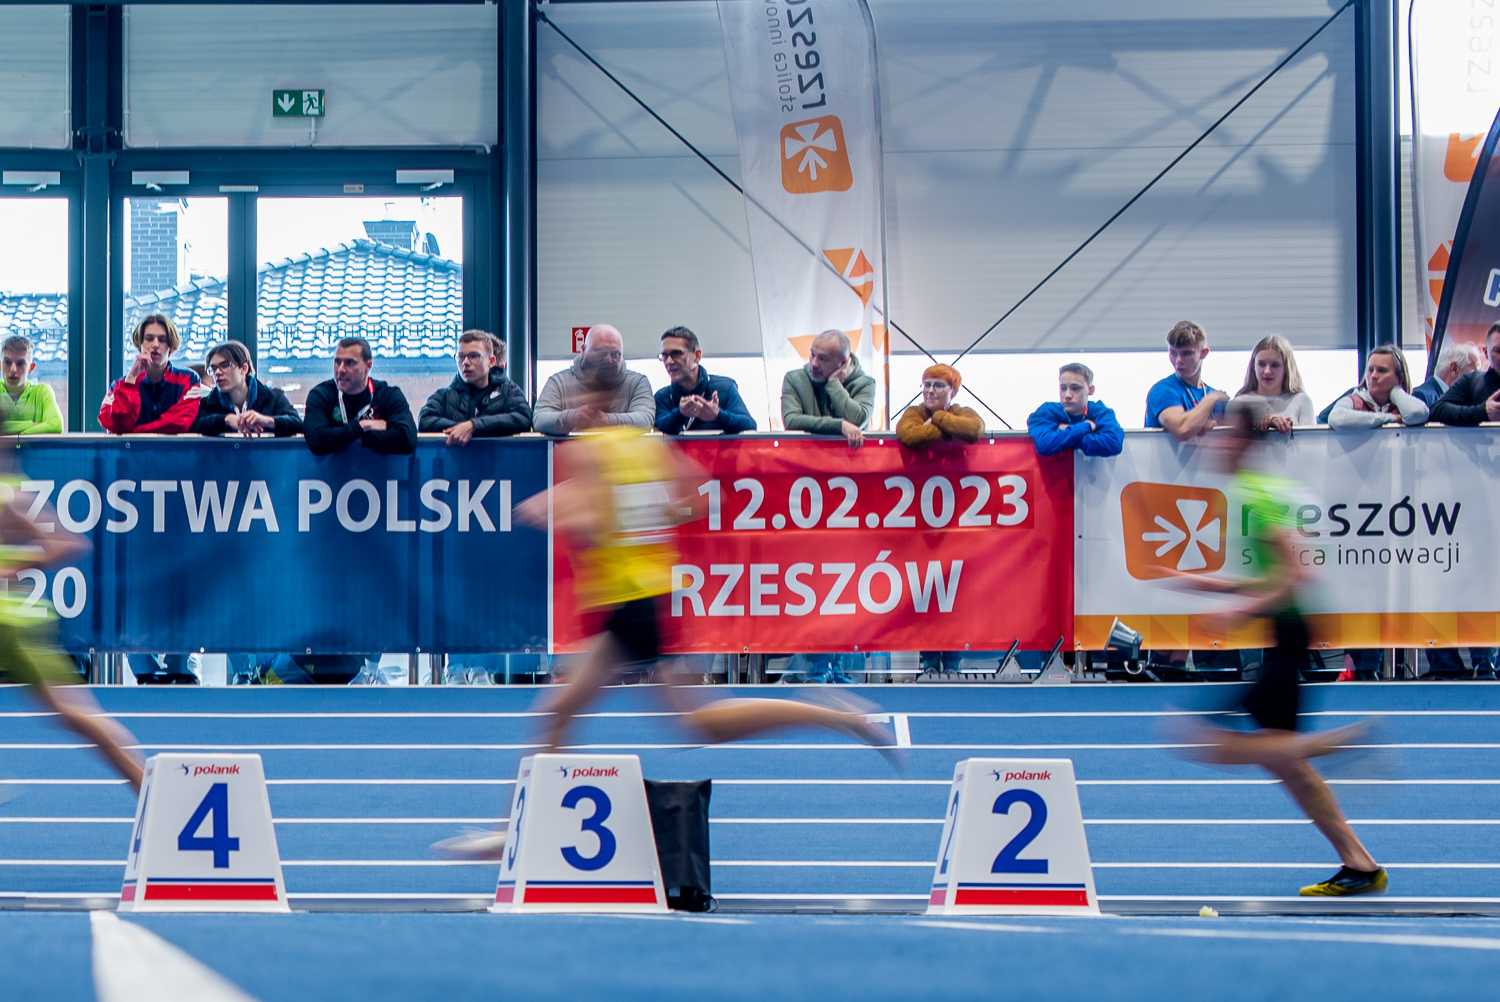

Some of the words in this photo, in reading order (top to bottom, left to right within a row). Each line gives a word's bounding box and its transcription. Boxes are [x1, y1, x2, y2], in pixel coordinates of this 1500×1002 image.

[298, 478, 512, 533] POLSKI
[671, 549, 964, 617] RZESZÓW
[1338, 542, 1460, 572] innowacji
[194, 763, 241, 776] polanik
[572, 765, 619, 779] polanik
[1004, 770, 1052, 783] polanik
[178, 782, 240, 868] 4
[508, 786, 526, 871] 3
[560, 785, 617, 871] 3
[940, 789, 960, 875] 2
[990, 788, 1049, 874] 2
